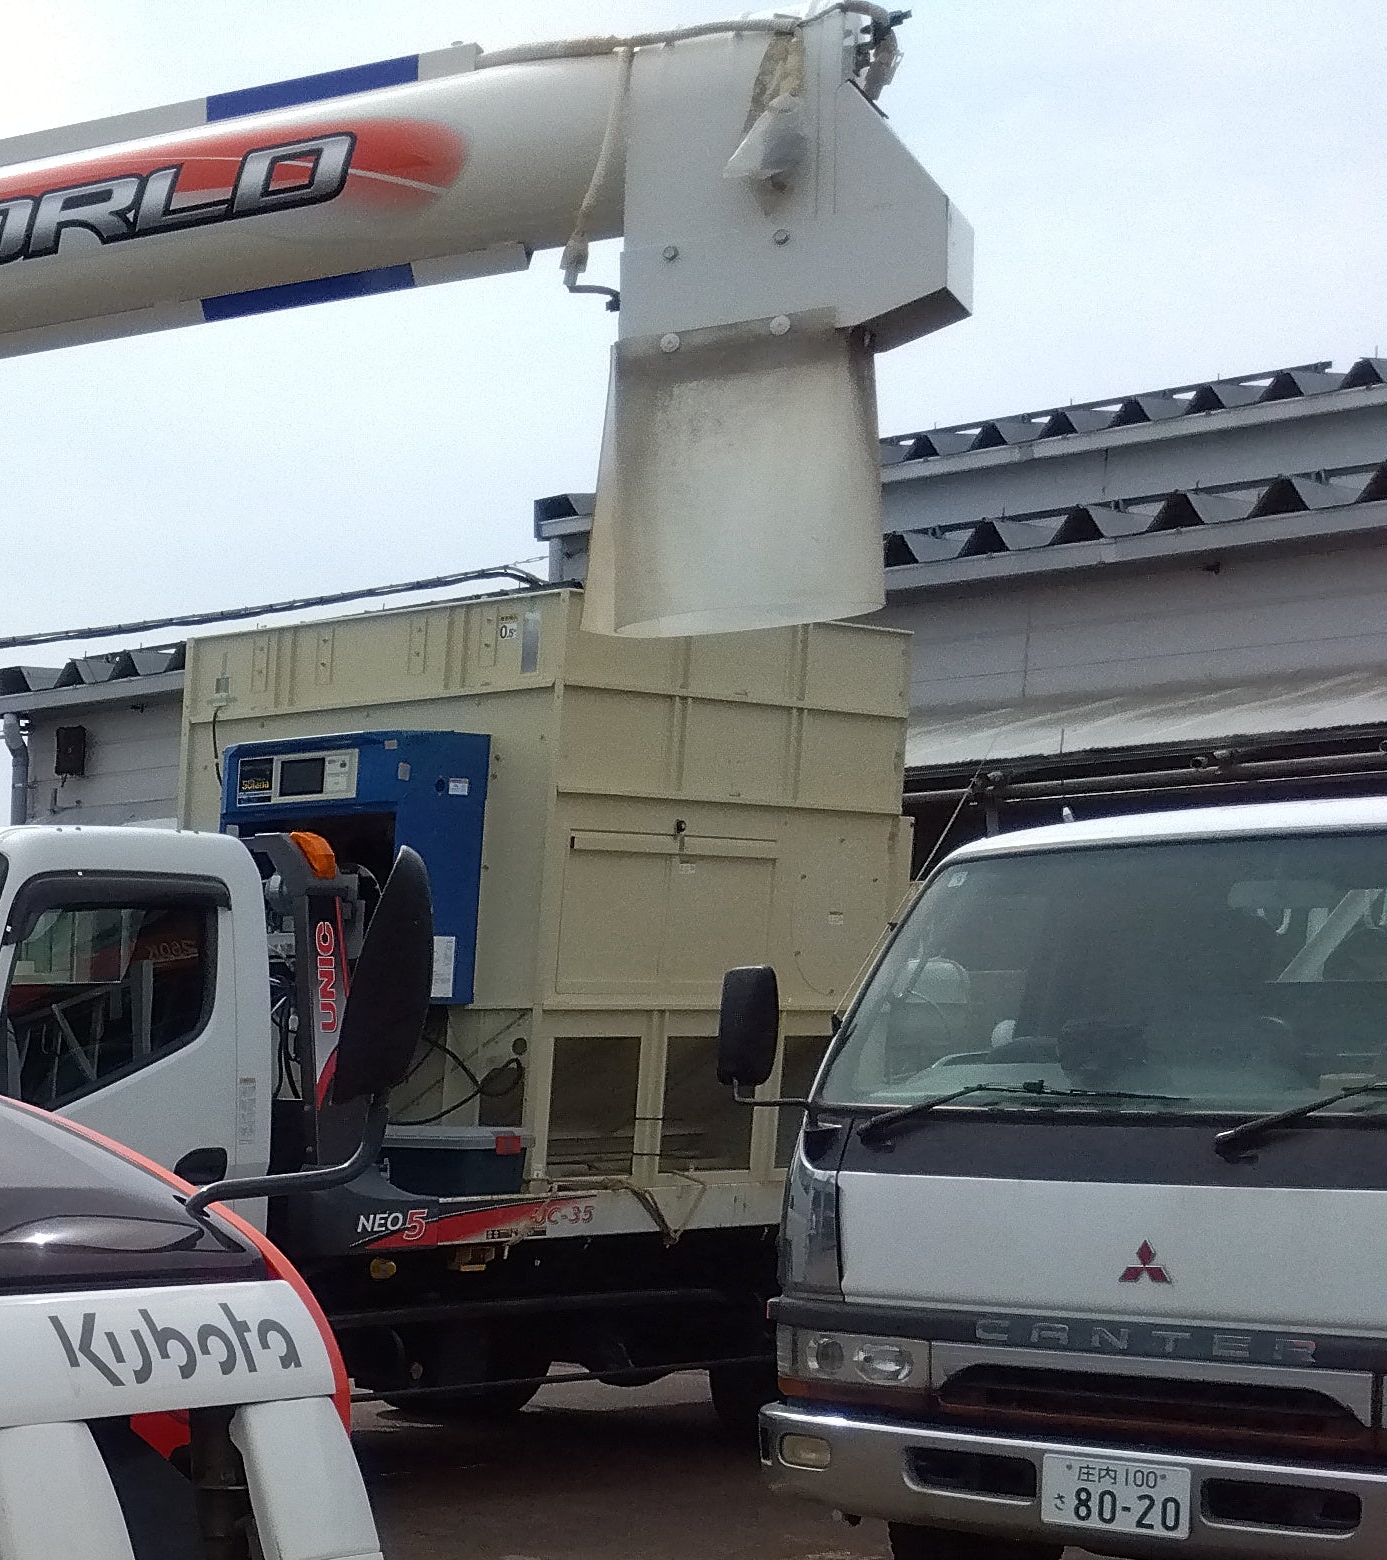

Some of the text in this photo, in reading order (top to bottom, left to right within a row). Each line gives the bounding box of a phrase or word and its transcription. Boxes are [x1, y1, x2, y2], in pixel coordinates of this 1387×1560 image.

[315, 921, 338, 1033] UNIC
[48, 1303, 303, 1387] Kubota
[974, 1319, 1318, 1364] CANTER
[1077, 1464, 1158, 1489] 庄内 100
[1073, 1487, 1181, 1532] 80-20
